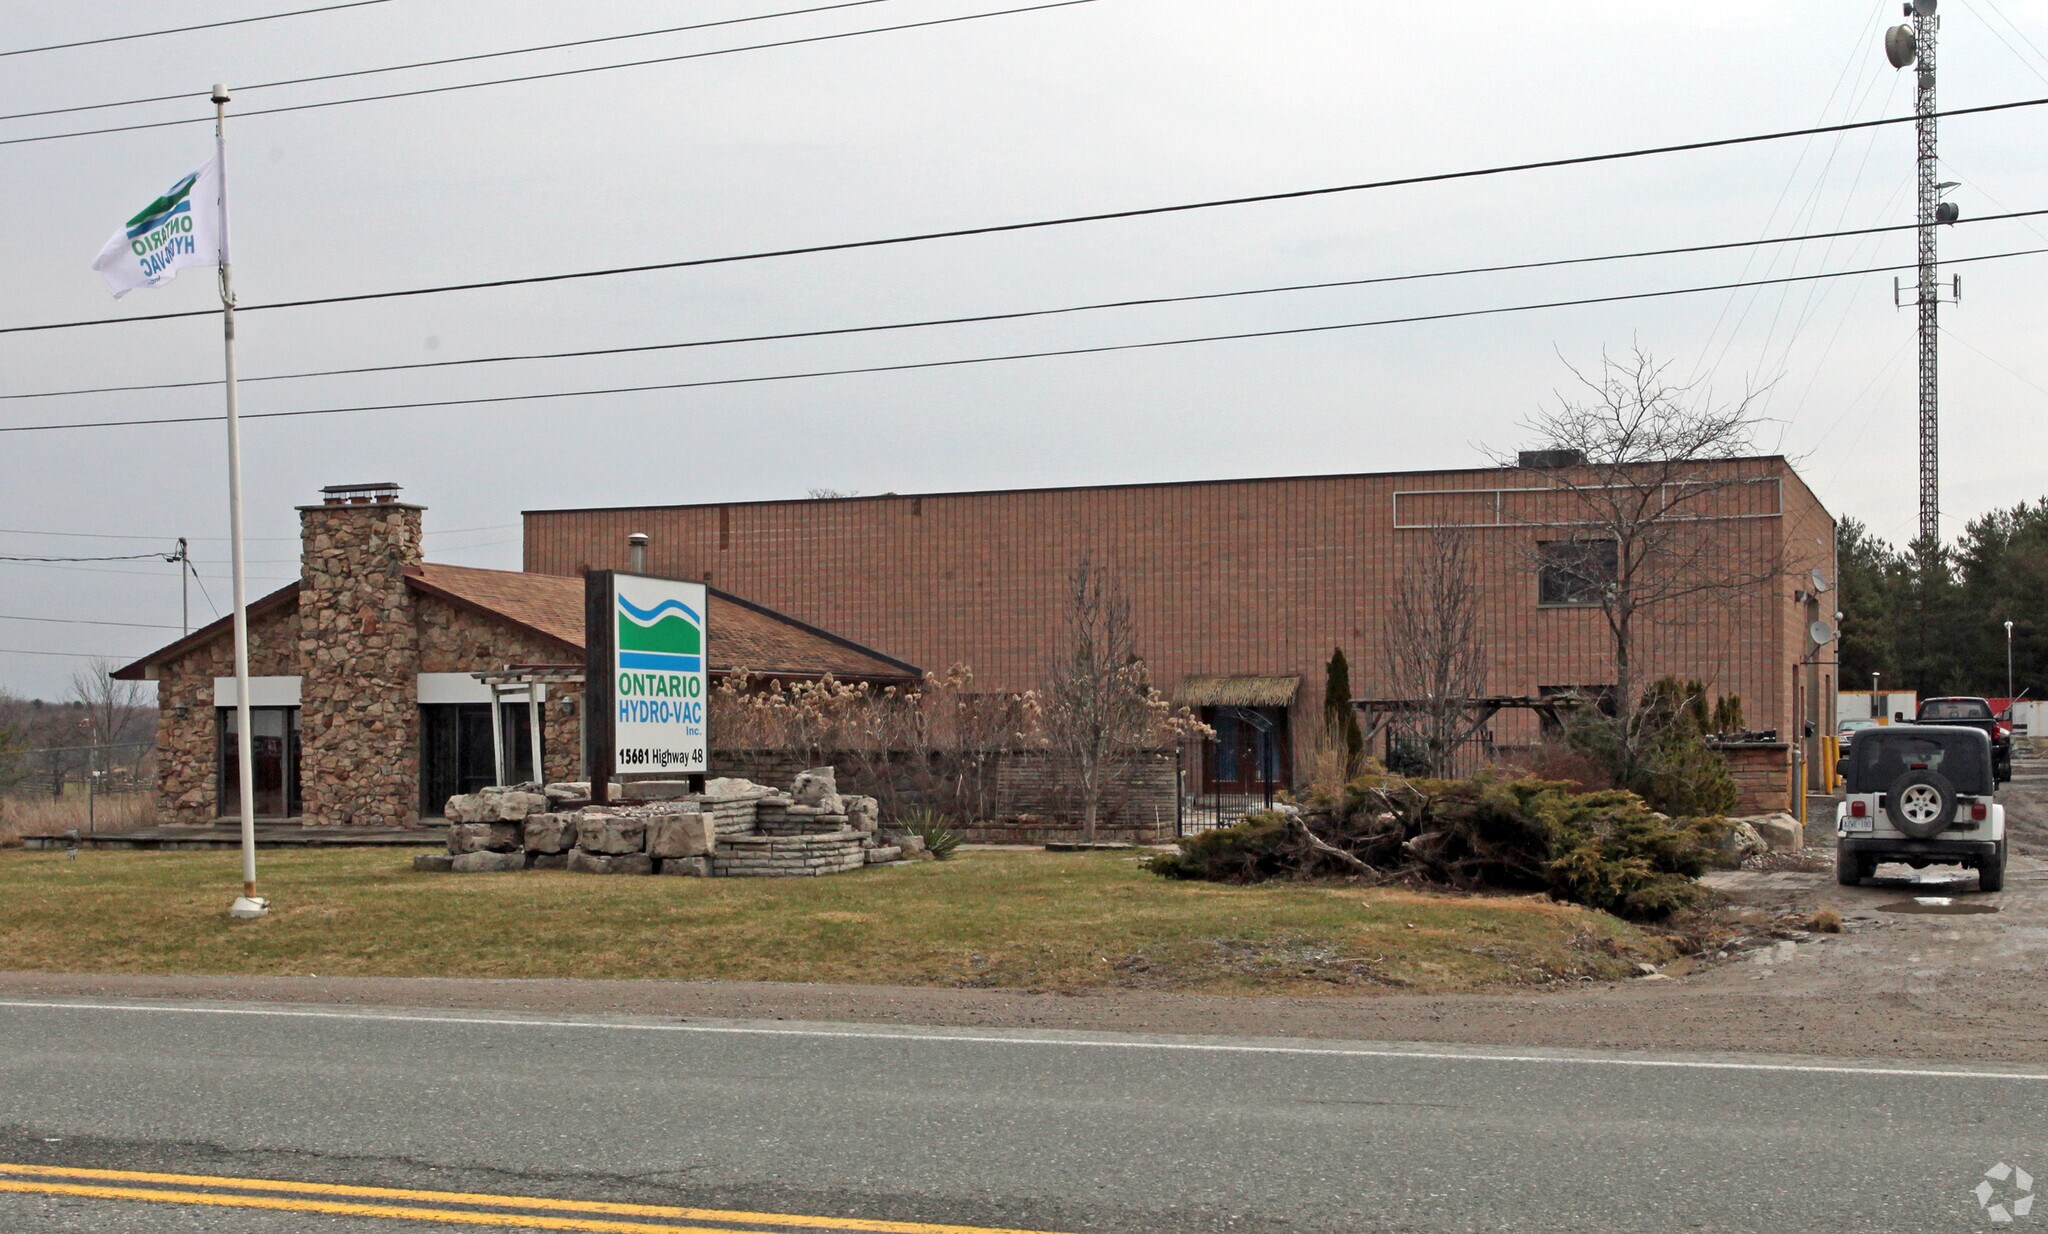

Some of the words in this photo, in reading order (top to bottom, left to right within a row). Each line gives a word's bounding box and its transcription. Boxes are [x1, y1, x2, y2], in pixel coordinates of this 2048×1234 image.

[619, 672, 701, 698] ONTARIO
[619, 699, 702, 724] HYDRO-VAC
[686, 726, 702, 736] Inc.
[619, 748, 649, 765] 15681
[652, 748, 690, 768] Highway
[691, 748, 704, 763] 48
